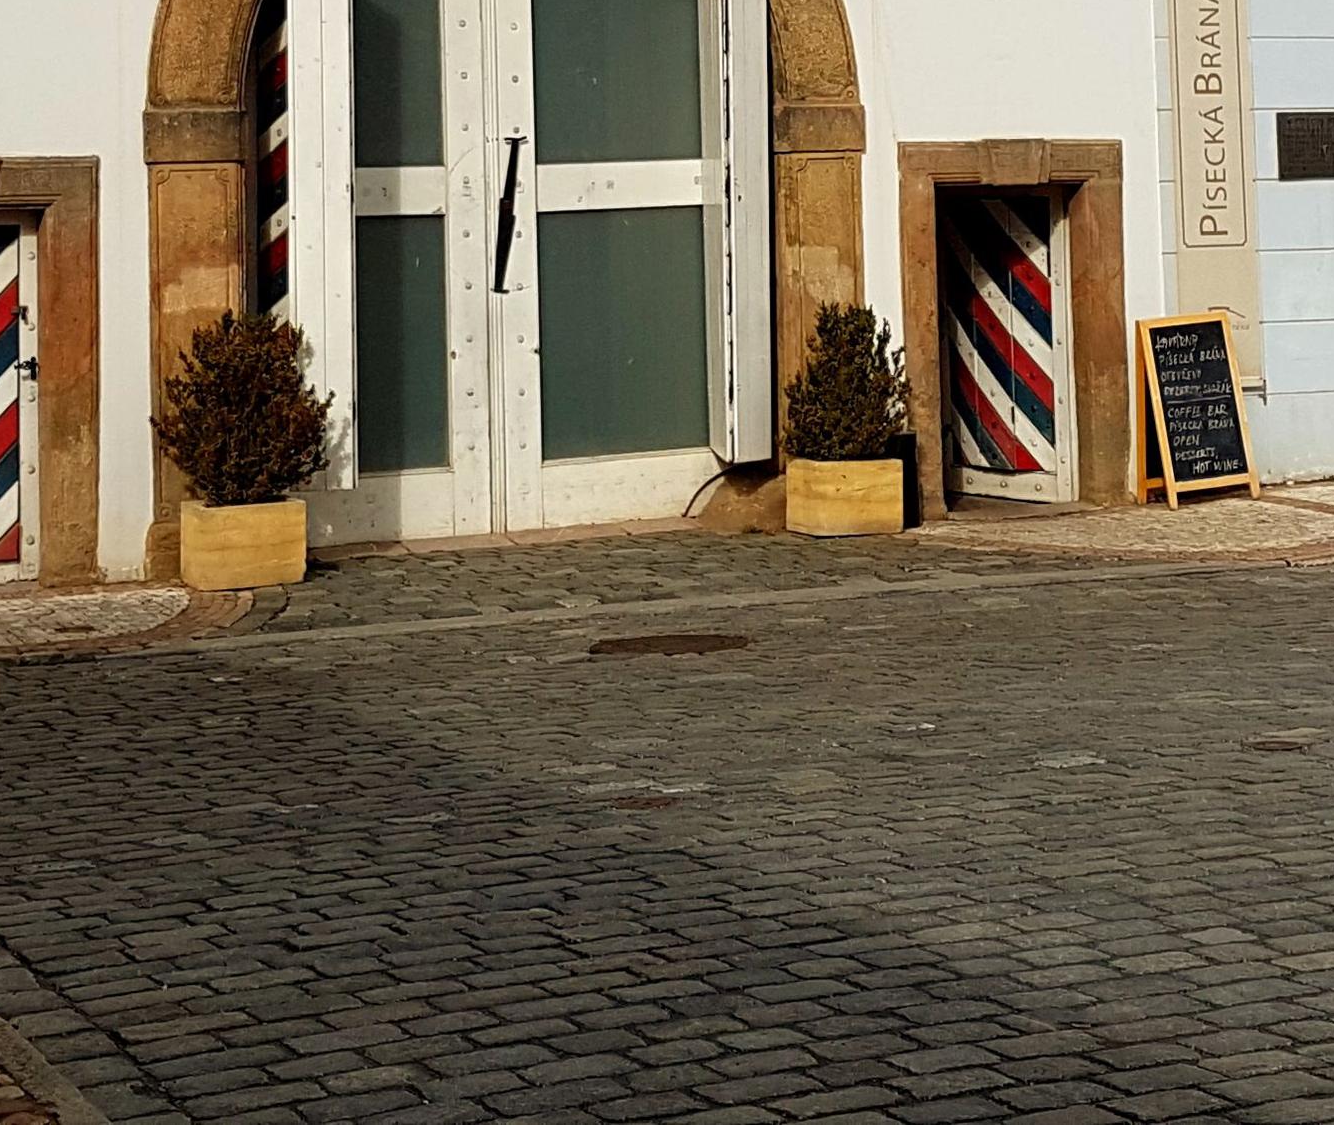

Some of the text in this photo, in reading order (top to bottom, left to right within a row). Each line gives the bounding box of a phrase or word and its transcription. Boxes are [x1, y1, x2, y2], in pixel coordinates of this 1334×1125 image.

[1207, 404, 1229, 417] BAR
[1172, 434, 1200, 447] OPEN
[1192, 460, 1211, 475] HOT
